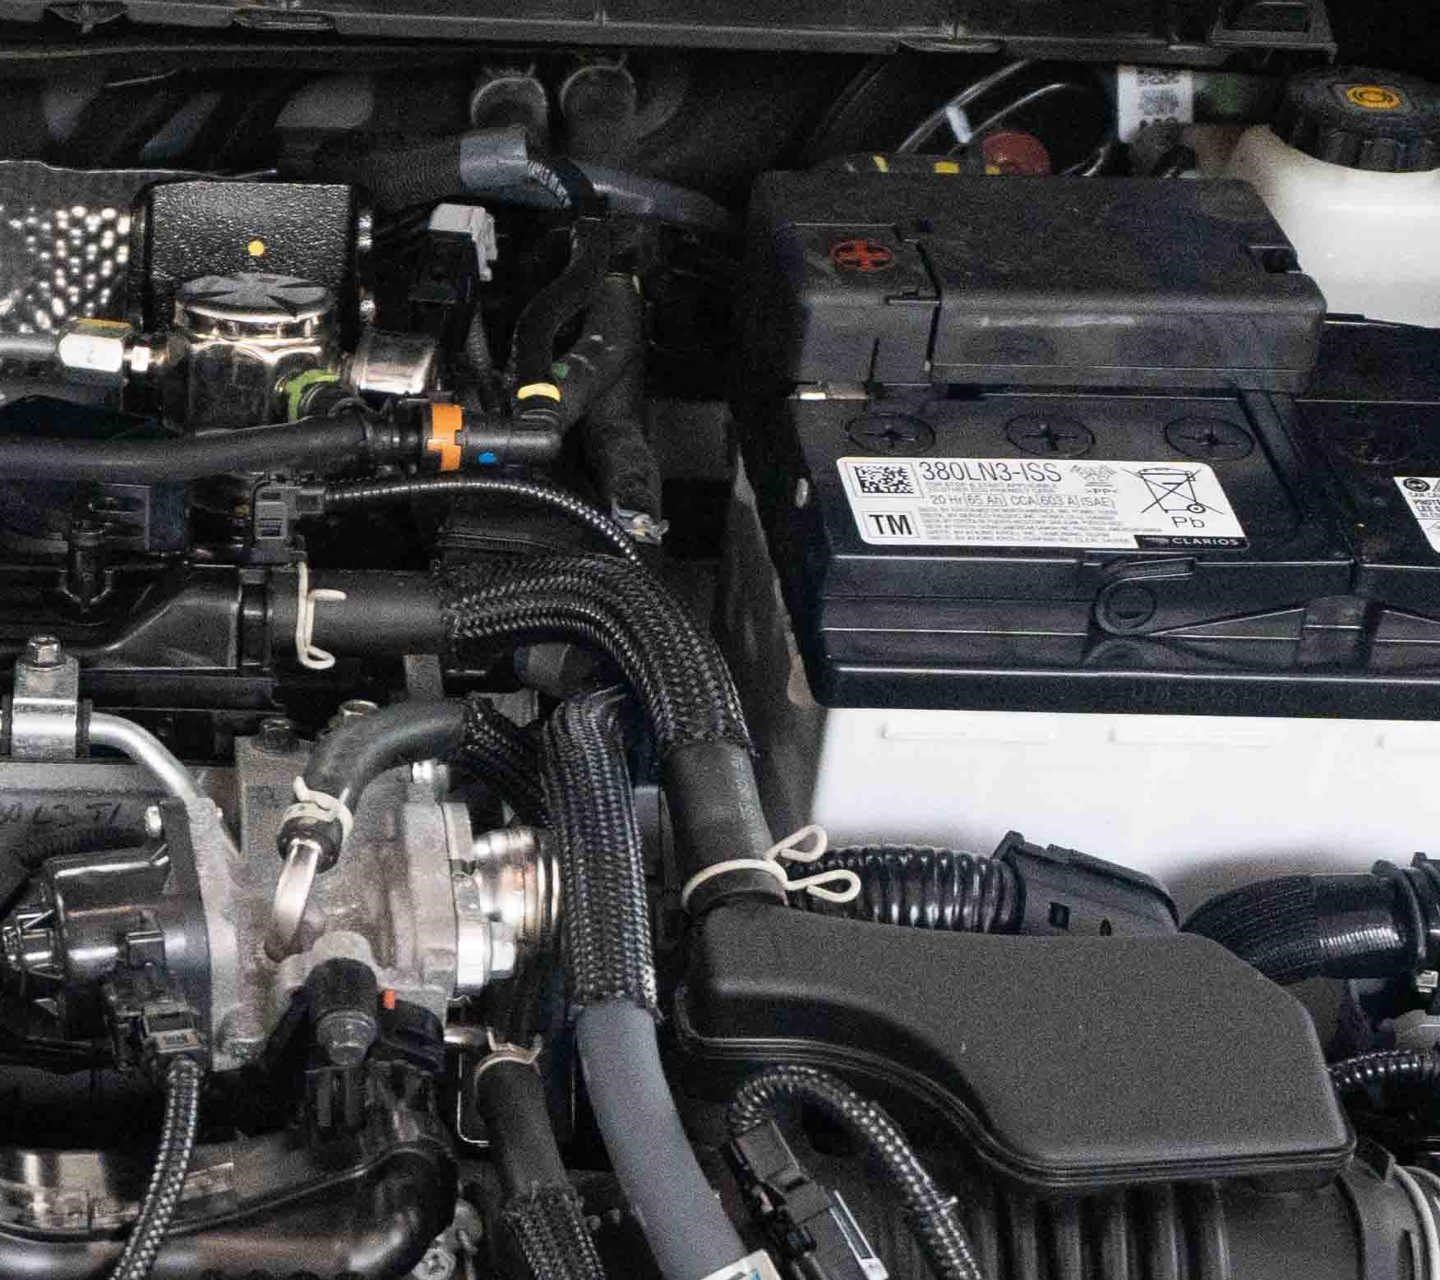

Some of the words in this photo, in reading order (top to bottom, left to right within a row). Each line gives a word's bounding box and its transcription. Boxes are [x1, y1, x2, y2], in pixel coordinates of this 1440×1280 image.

[920, 461, 1062, 483] 380LN3-ISS
[869, 514, 913, 536] TM
[1171, 516, 1206, 529] Pb
[1172, 537, 1239, 546] CLARIOS
